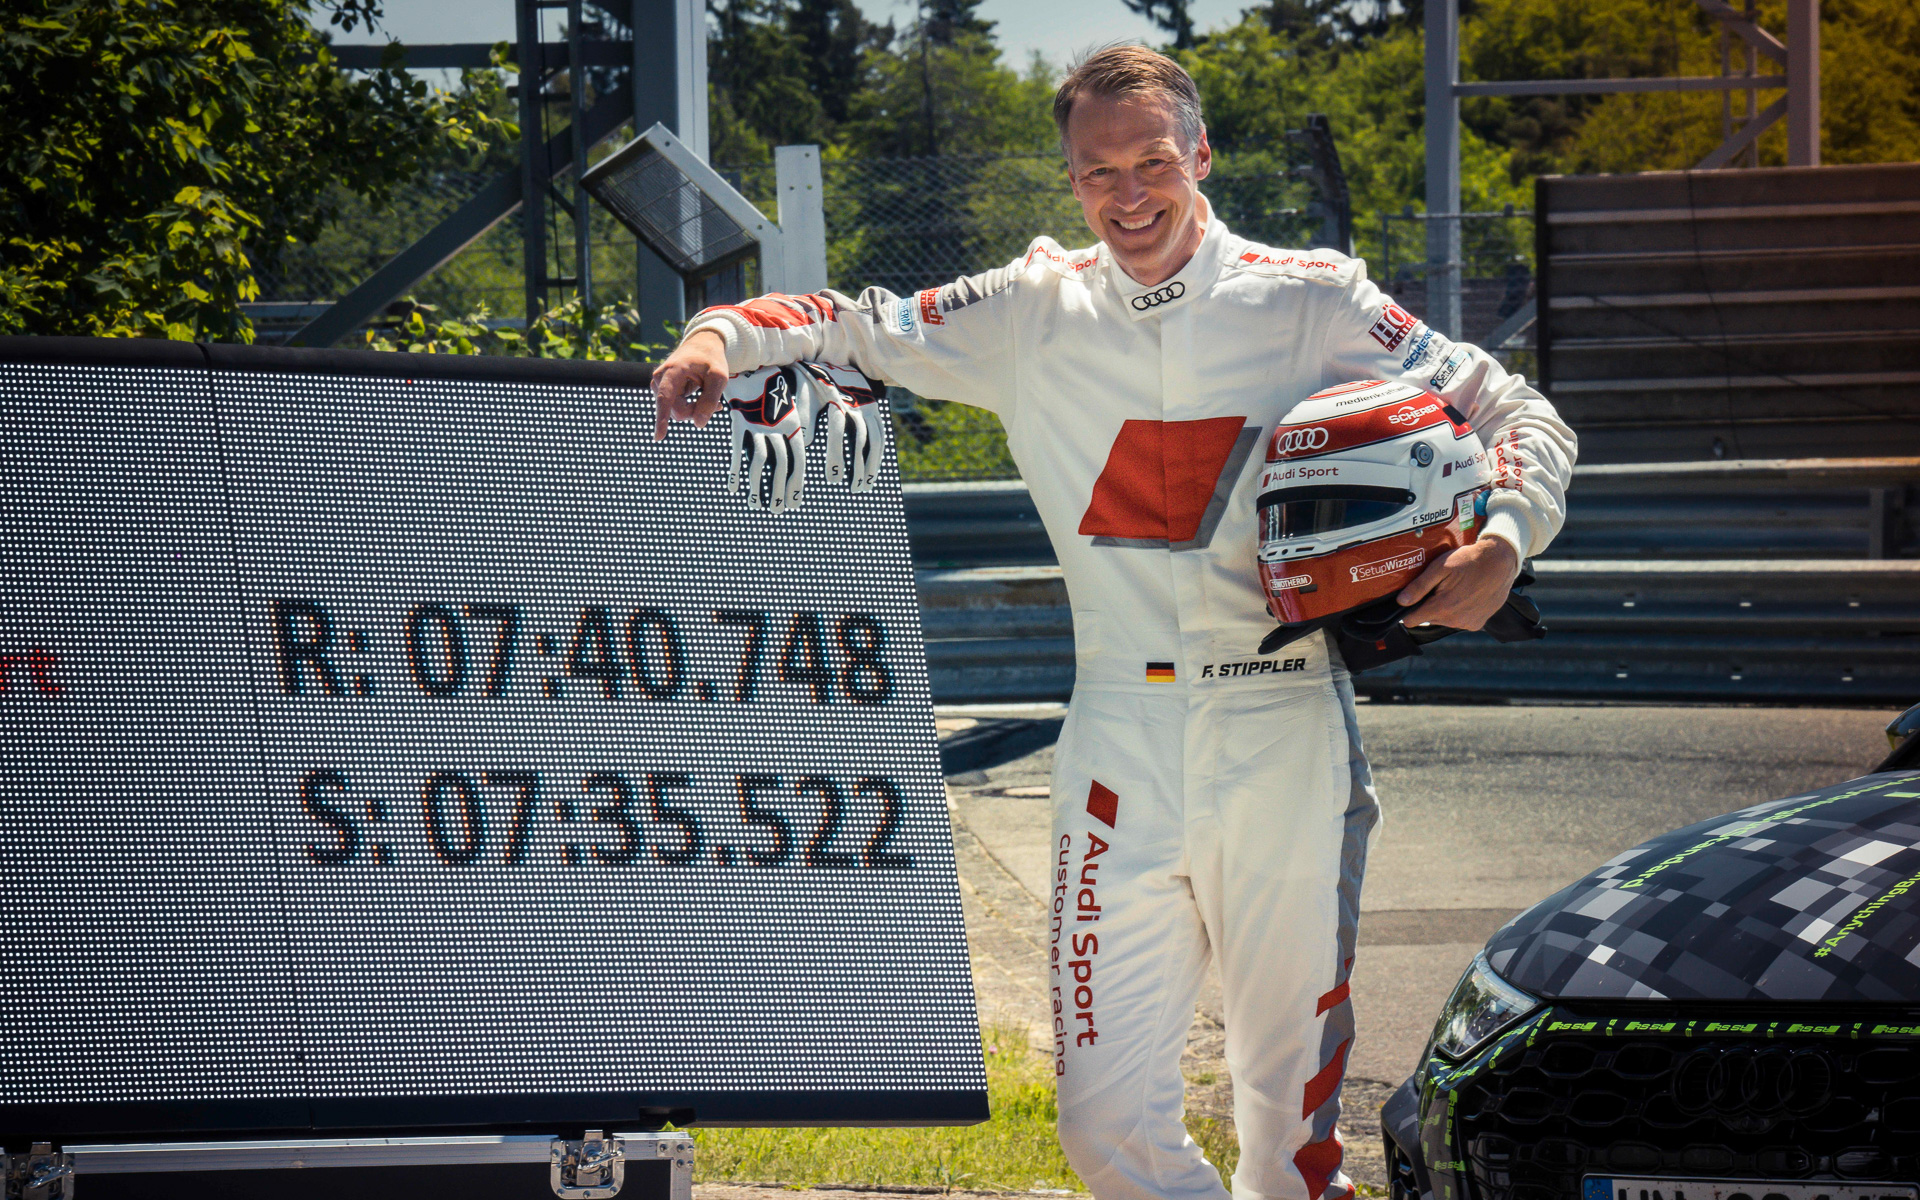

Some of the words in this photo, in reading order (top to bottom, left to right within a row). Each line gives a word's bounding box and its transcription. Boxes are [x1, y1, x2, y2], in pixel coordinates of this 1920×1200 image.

[1067, 256, 1099, 273] Spor
[1260, 256, 1293, 266] Audi
[1297, 260, 1338, 273] Sport
[1388, 403, 1440, 425] SCHERER
[1271, 469, 1296, 482] Audi
[1298, 467, 1339, 480] Sport
[1455, 456, 1475, 471] Audi
[1419, 508, 1449, 524] Stippler
[407, 603, 896, 703] 07:40.748
[1201, 664, 1214, 678] F.
[1218, 658, 1306, 677] STIPPLER
[424, 770, 915, 867] 07:35.522
[1076, 831, 1110, 921] Audi
[1051, 833, 1071, 976] customer
[1068, 933, 1099, 1048] Sport
[1052, 986, 1066, 1076] racing
